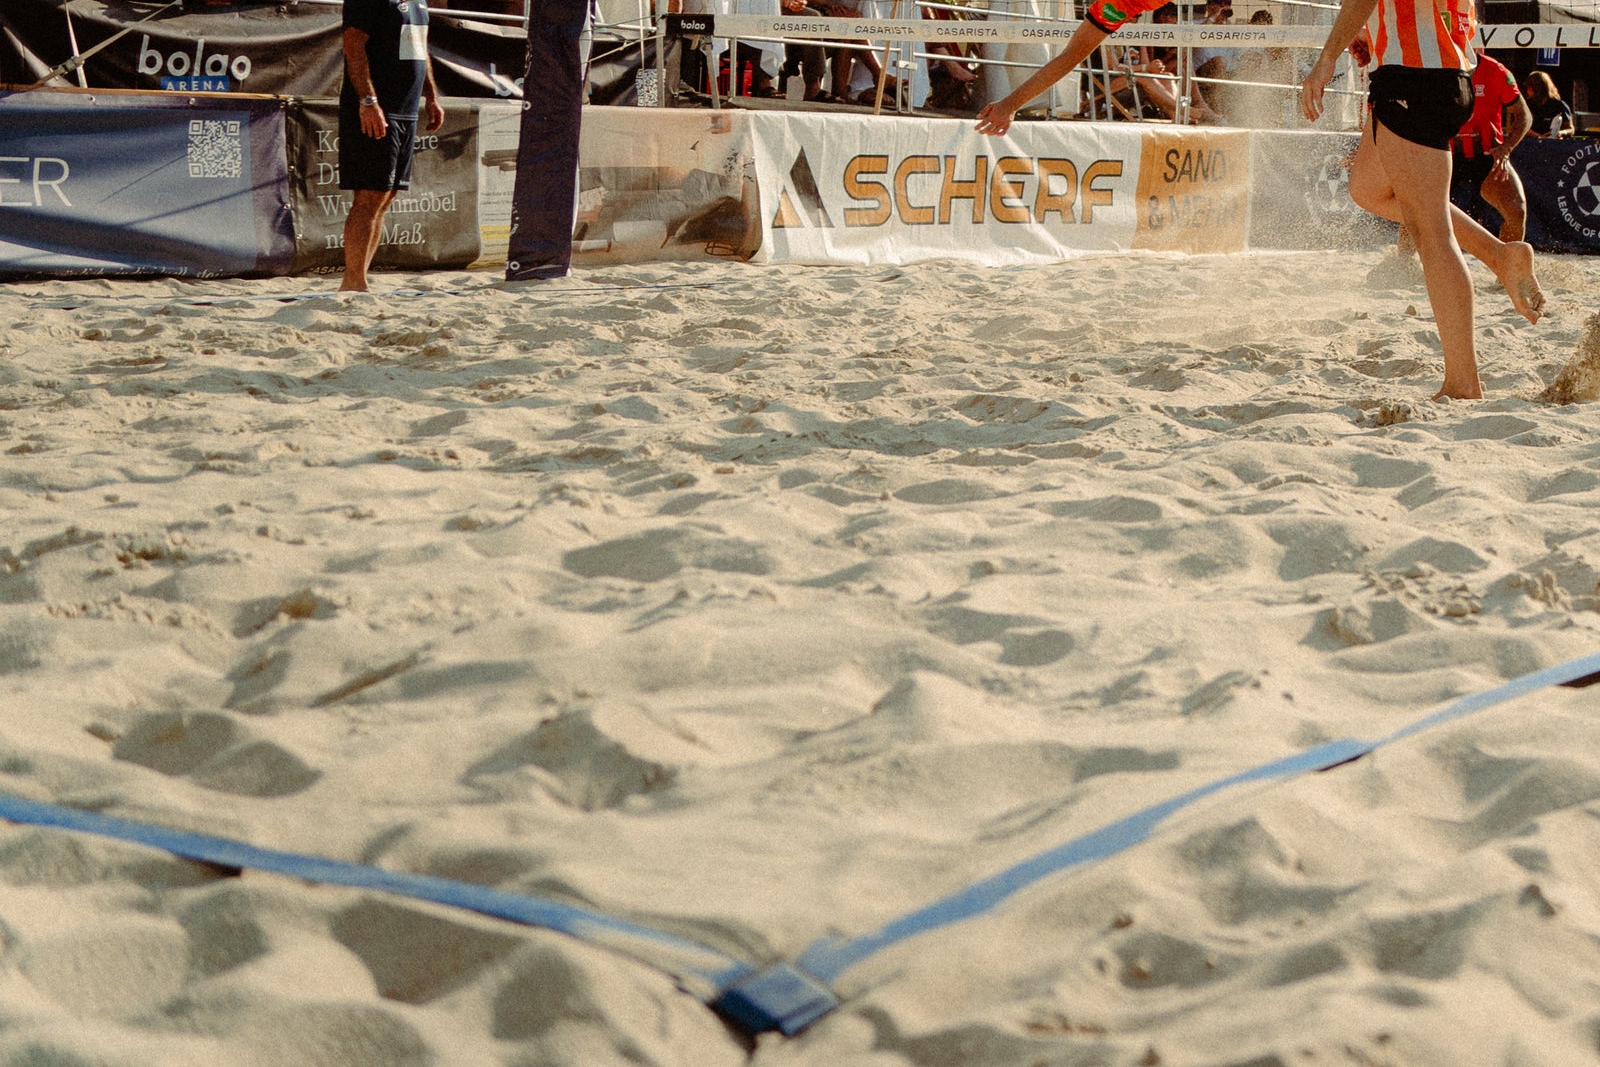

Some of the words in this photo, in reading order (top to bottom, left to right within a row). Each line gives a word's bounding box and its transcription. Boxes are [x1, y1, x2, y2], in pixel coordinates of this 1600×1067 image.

[680, 20, 706, 31] bolao
[772, 22, 831, 34] CASARISTA
[854, 24, 914, 35] CASARISTA
[936, 27, 998, 38] CASARISTA
[1022, 28, 1077, 39] CASARIS
[1109, 30, 1176, 41] CASARISTA
[1199, 30, 1267, 41] CASARISTA
[137, 34, 252, 81] bolao
[166, 80, 226, 91] ARENA
[1163, 148, 1227, 183] SAND
[843, 154, 1124, 226] SCHERF
[1148, 194, 1164, 231] &
[1557, 195, 1583, 232] LEAGUE
[1582, 227, 1597, 239] OF
